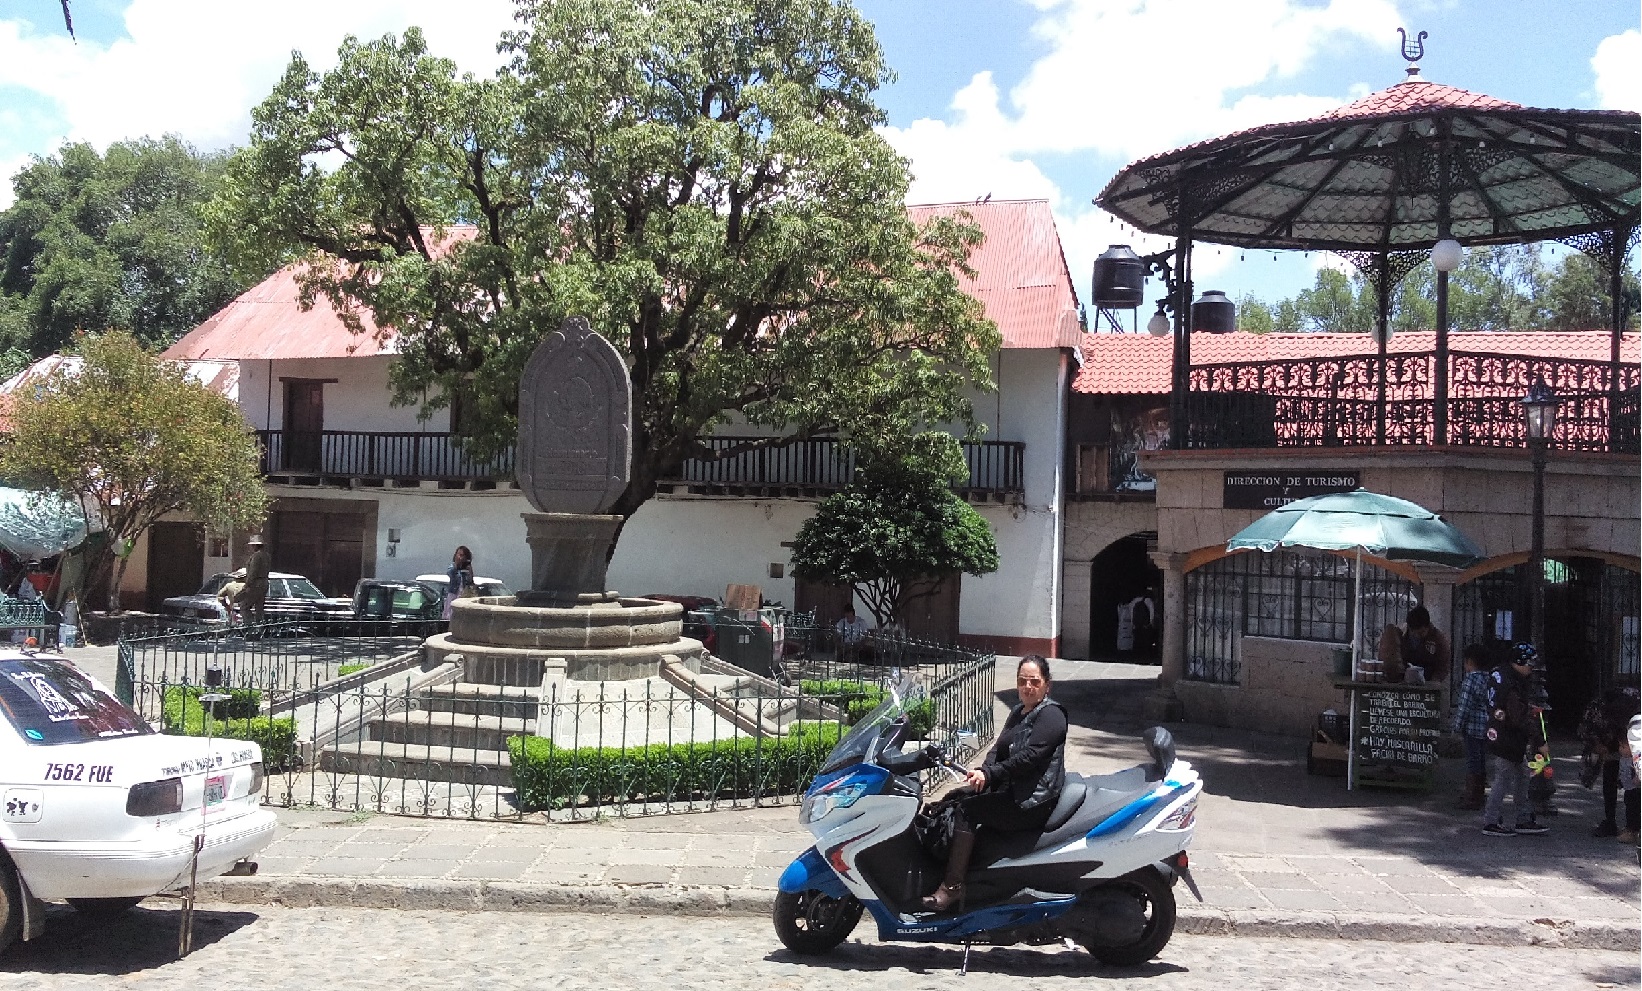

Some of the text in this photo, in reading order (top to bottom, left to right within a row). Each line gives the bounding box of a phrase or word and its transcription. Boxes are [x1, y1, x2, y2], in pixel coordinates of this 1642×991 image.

[1227, 476, 1355, 487] DIRECCION DE TURISMO
[1282, 486, 1290, 495] Y
[44, 763, 114, 782] 7562 FUE
[896, 926, 938, 934] SUZUKI
